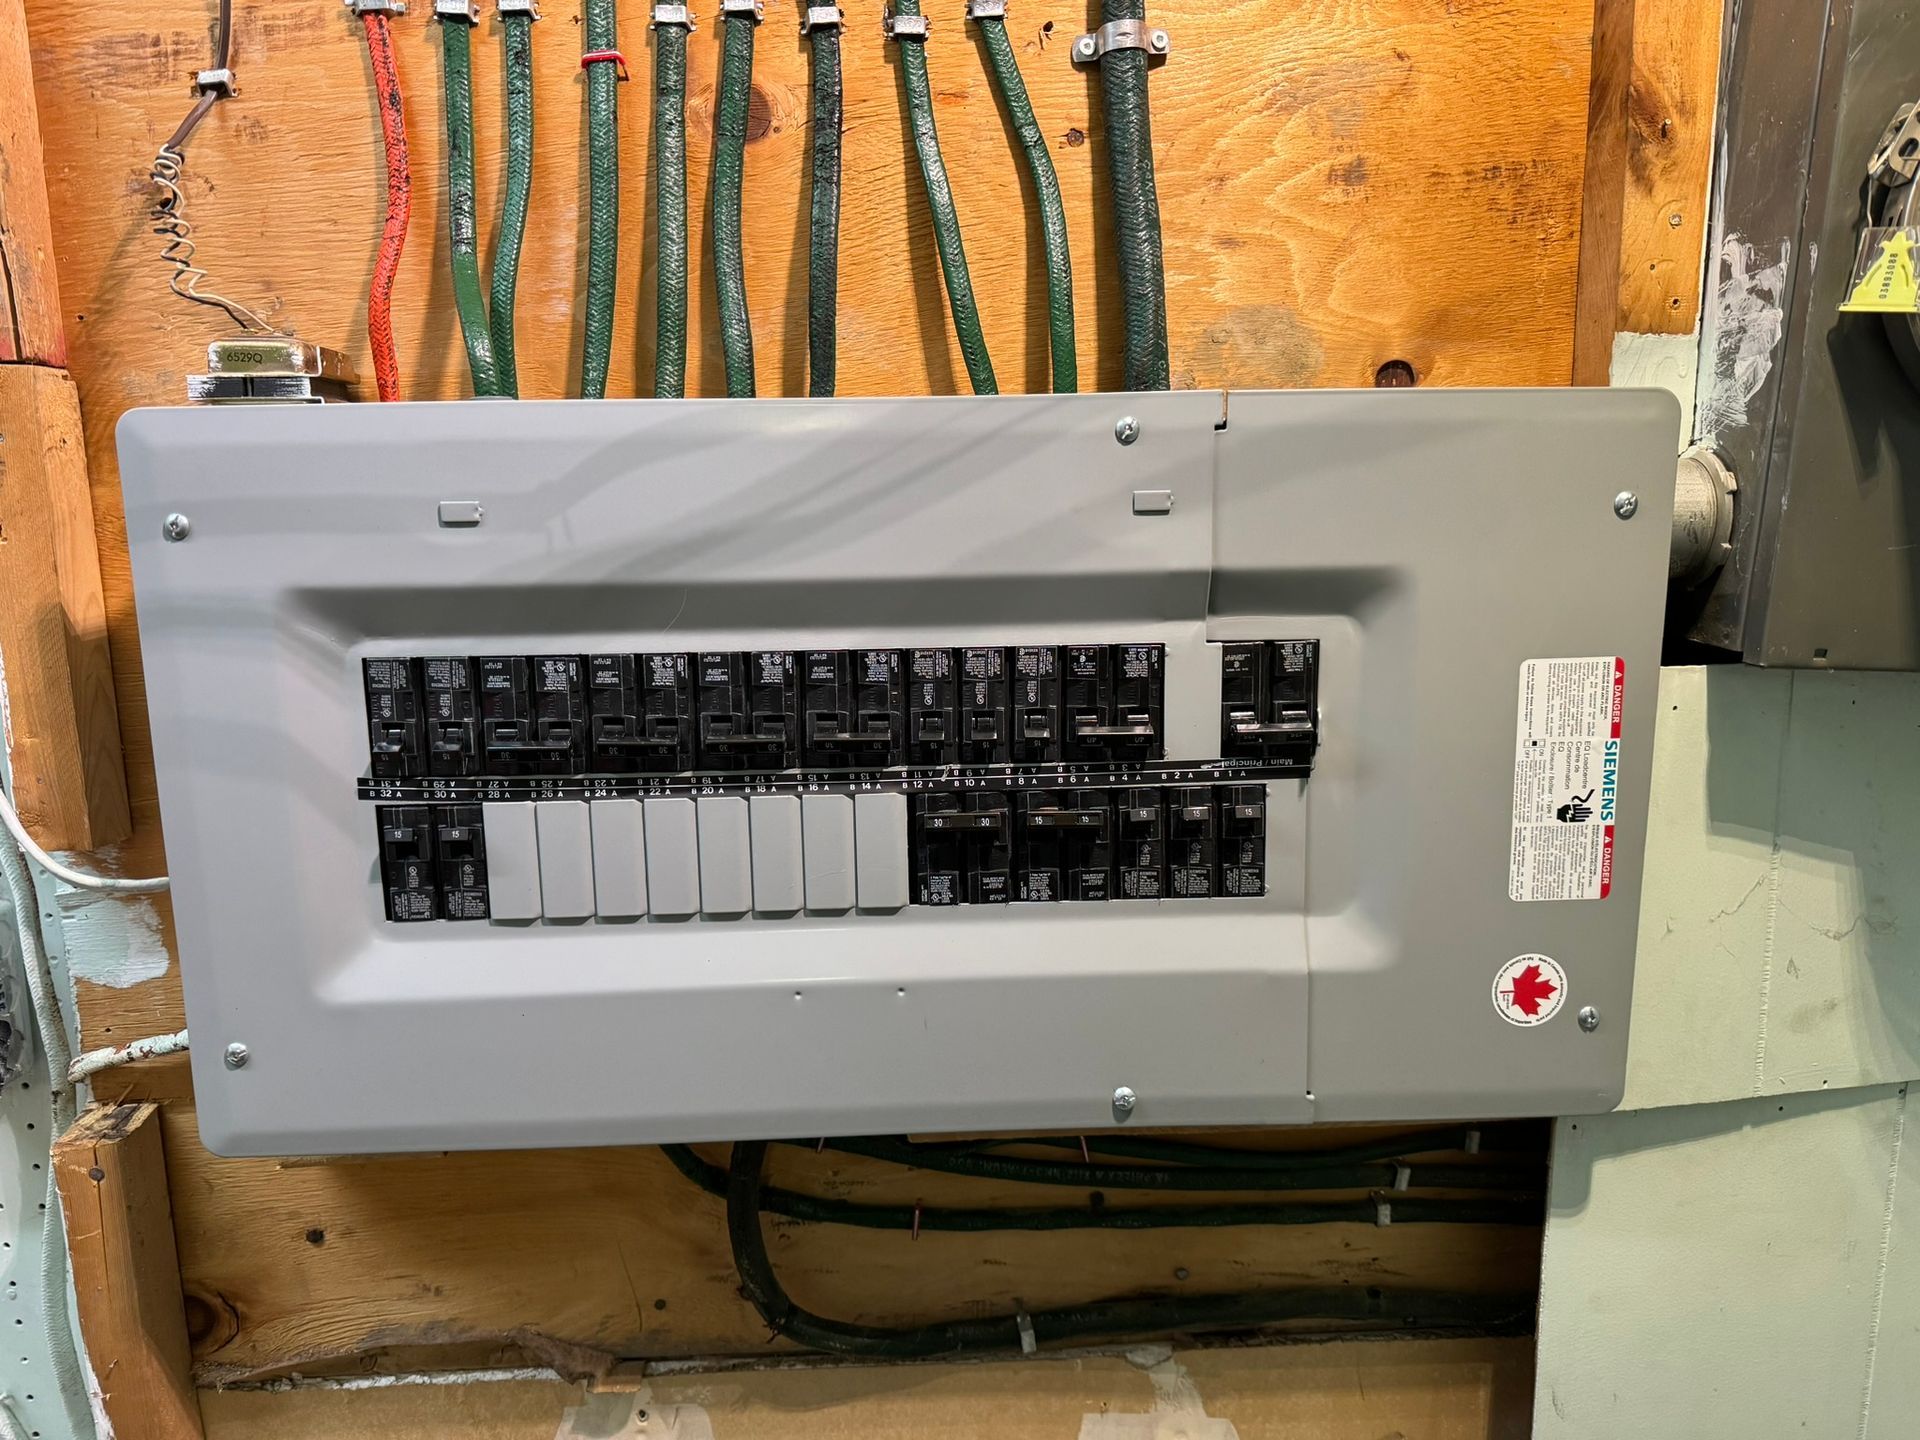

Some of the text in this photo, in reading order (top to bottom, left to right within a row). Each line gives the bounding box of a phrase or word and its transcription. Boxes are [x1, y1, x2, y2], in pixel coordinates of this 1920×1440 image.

[227, 352, 263, 364] 6529Q
[1612, 684, 1622, 723] DANGER
[1558, 742, 1565, 752] EQ
[1548, 742, 1556, 771] Enclosure
[1574, 741, 1582, 773] Centre de
[1222, 759, 1262, 769] Principal
[1564, 741, 1573, 790] Consommation
[1581, 741, 1591, 789] EQ Loadcentre
[965, 779, 975, 787] 10
[1600, 740, 1618, 821] SIEMENS
[1245, 808, 1253, 816] 15
[1546, 800, 1554, 814] Type
[934, 818, 943, 827] 30
[981, 818, 990, 826] 30
[1035, 816, 1043, 825] 15
[1082, 815, 1090, 823] 15
[394, 831, 402, 839] 15
[452, 831, 460, 839] 15
[1602, 847, 1611, 884] DANGER
